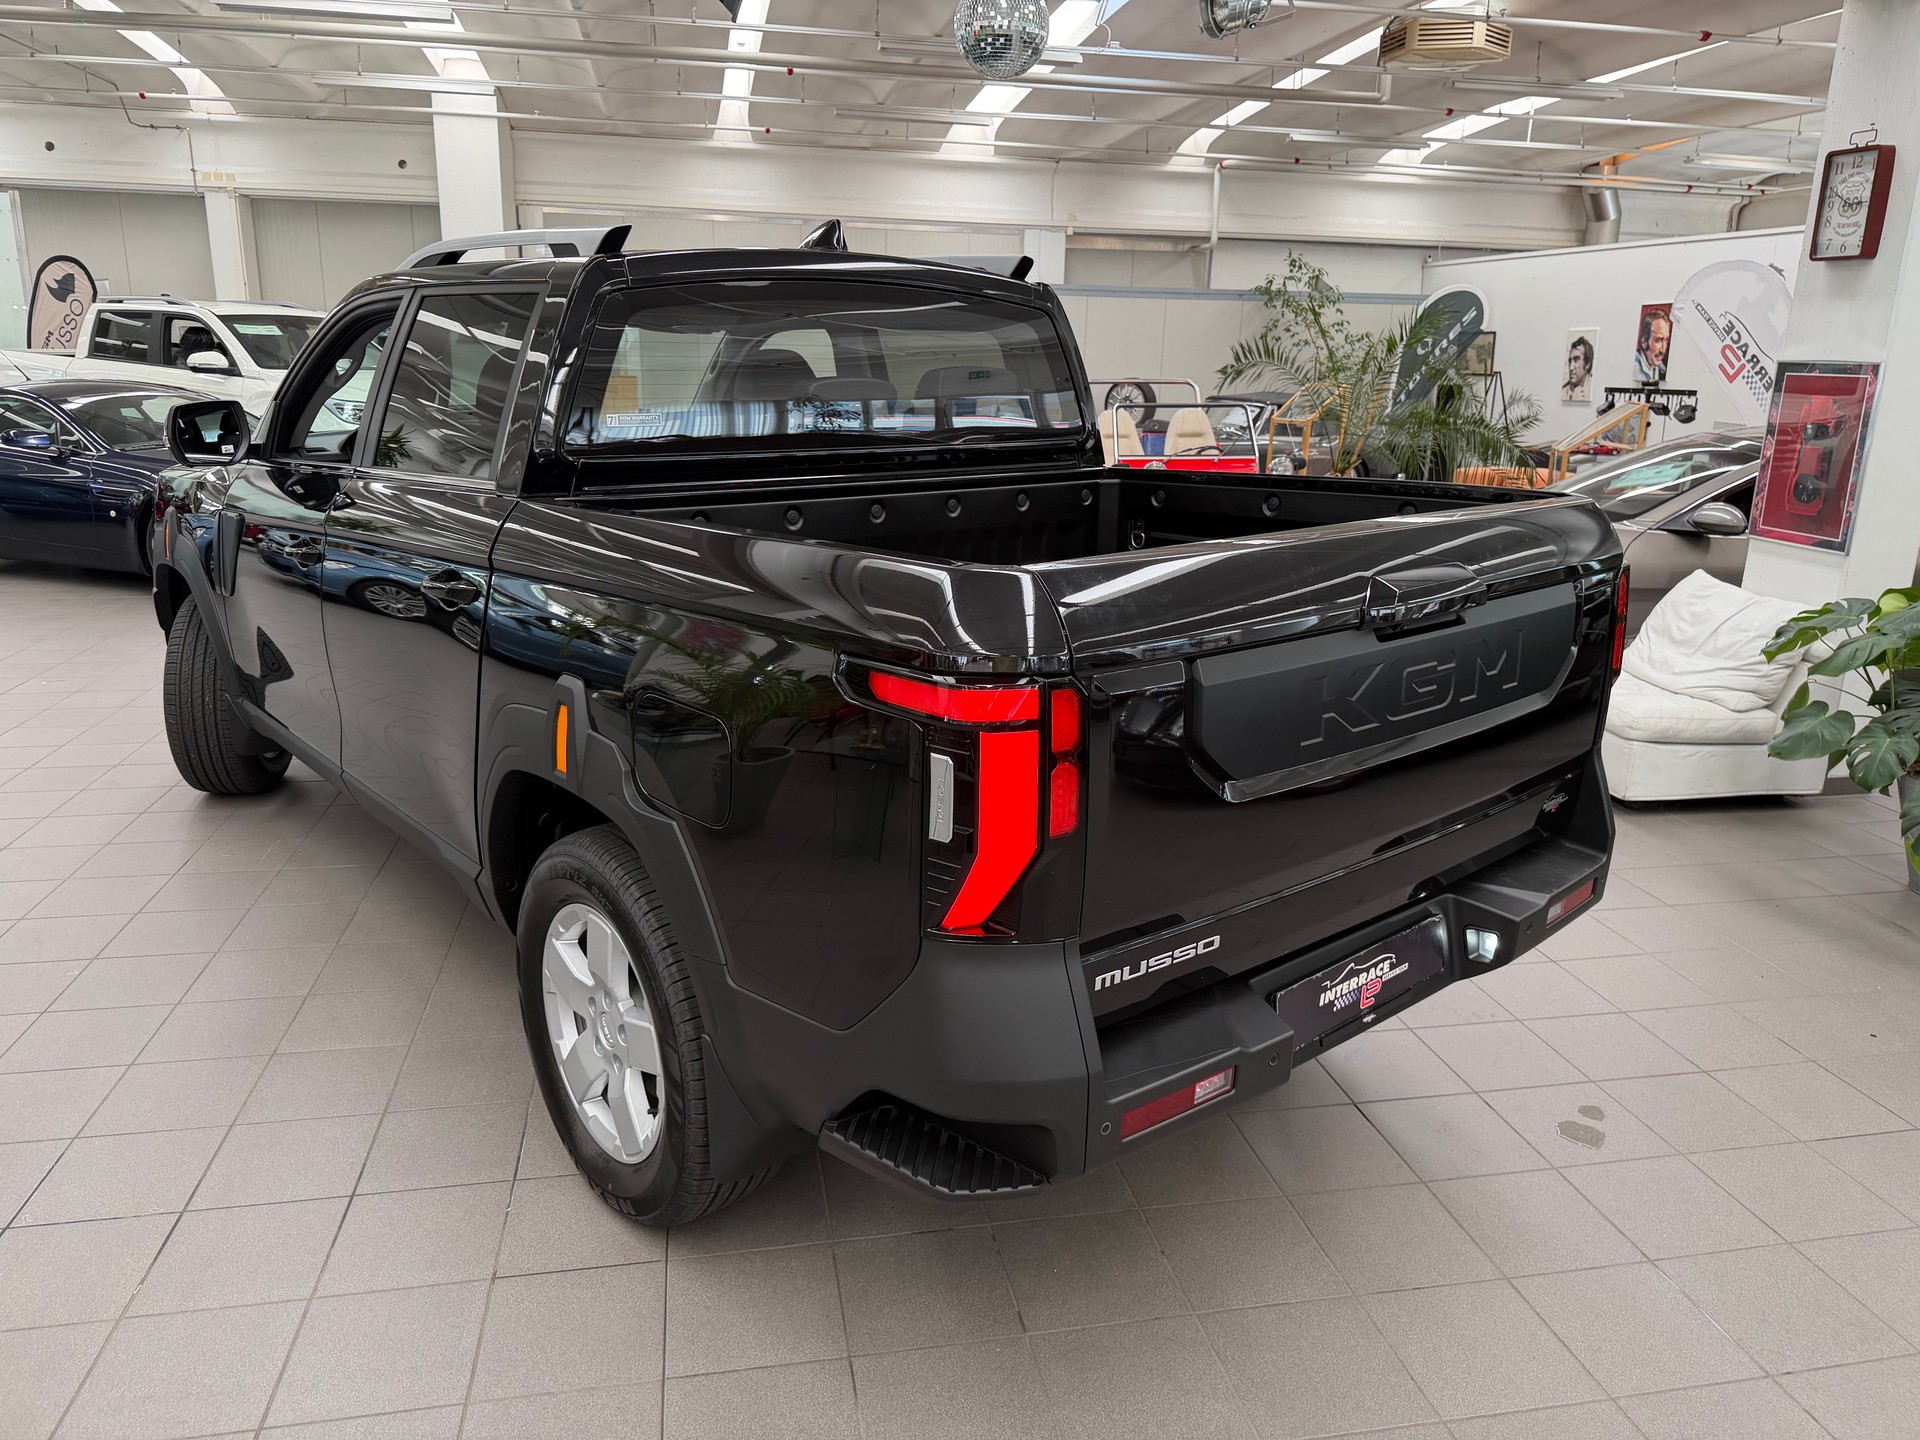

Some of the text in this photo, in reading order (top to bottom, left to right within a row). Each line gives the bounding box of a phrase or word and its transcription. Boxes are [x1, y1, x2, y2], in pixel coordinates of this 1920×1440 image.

[1834, 162, 1844, 175] 11
[1851, 155, 1864, 169] 12
[1824, 216, 1832, 229] 8
[1827, 200, 1835, 213] 9
[1825, 238, 1833, 251] 7
[1840, 240, 1847, 253] 6
[41, 330, 54, 349] GM
[52, 298, 84, 349] SSO
[1396, 306, 1478, 403] TORES
[1300, 628, 1524, 746] KGM
[1094, 935, 1221, 991] MUSSO
[1319, 959, 1391, 1007] INTERRACE
